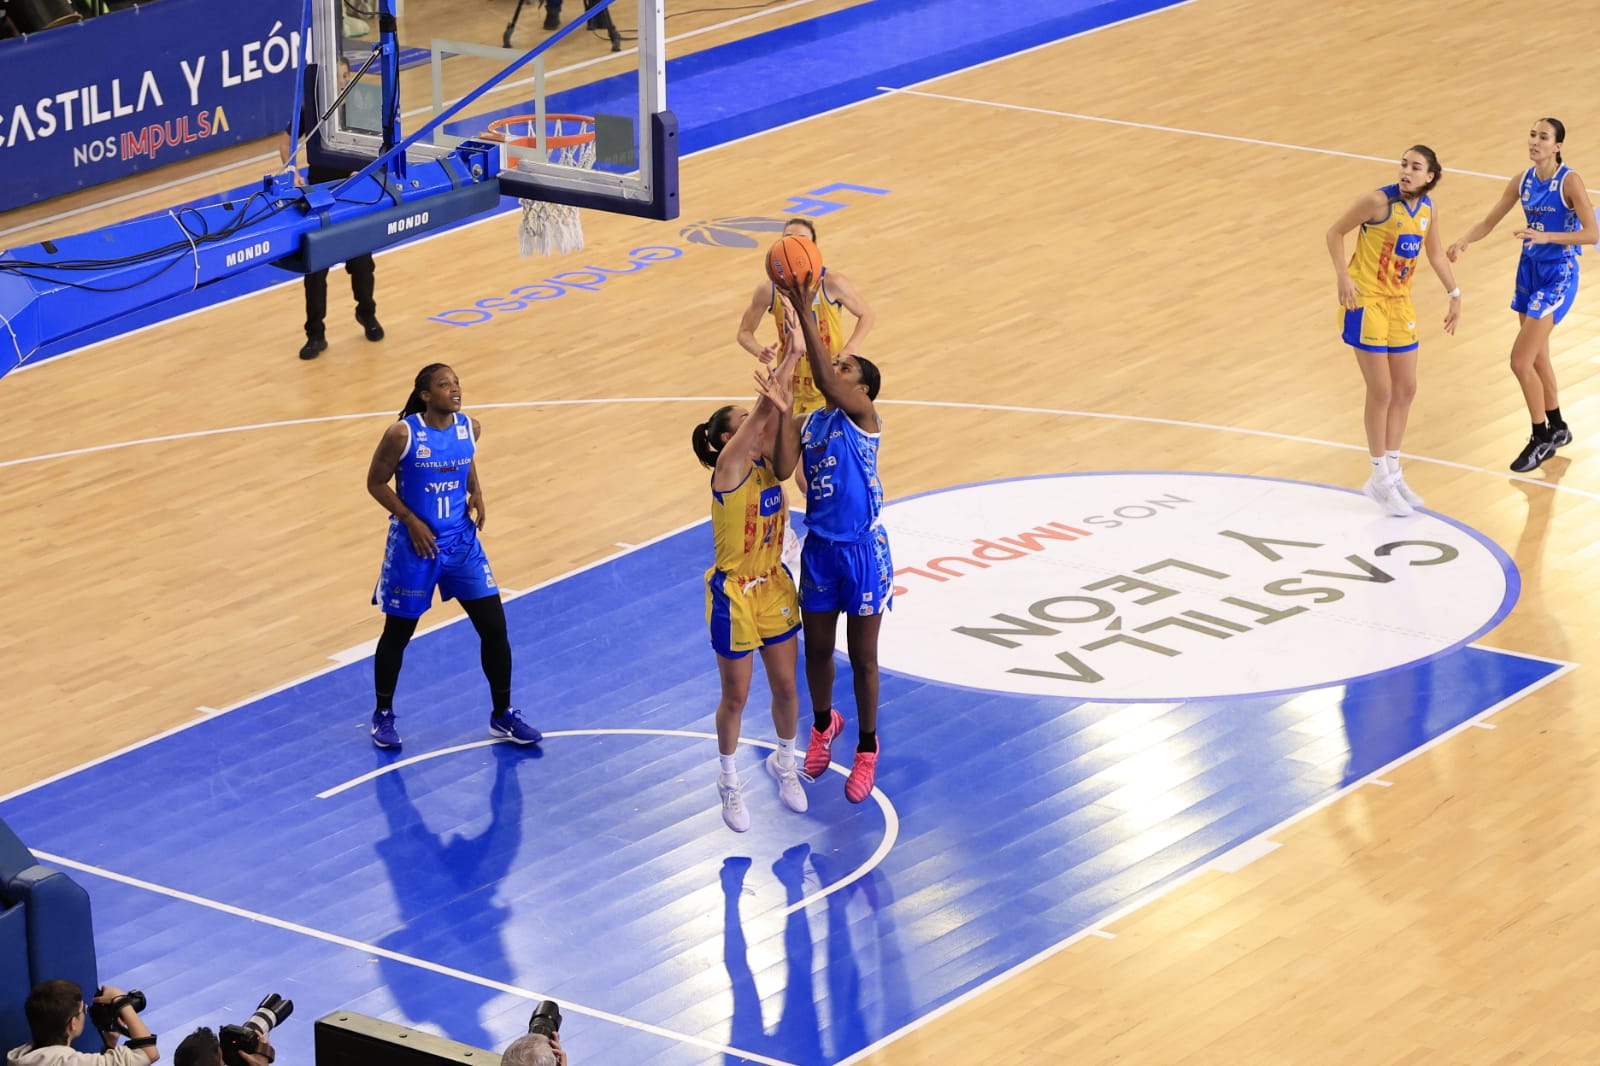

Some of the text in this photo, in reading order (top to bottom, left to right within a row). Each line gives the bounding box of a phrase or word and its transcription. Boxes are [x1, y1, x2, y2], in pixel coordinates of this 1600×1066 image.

[0, 20, 313, 148] ASTILLA Y LEÓN
[73, 105, 230, 167] NOS IMPULSA
[387, 211, 430, 235] MONDO
[226, 241, 270, 268] MONDO
[426, 245, 684, 327] endesa
[414, 460, 449, 468] CASTILLA
[450, 458, 456, 467] Y
[811, 474, 834, 500] 55
[437, 496, 450, 519] 11
[1083, 493, 1195, 529] NOS
[951, 529, 1326, 650] Y LEÓN
[1005, 540, 1460, 684] CASTILLA
